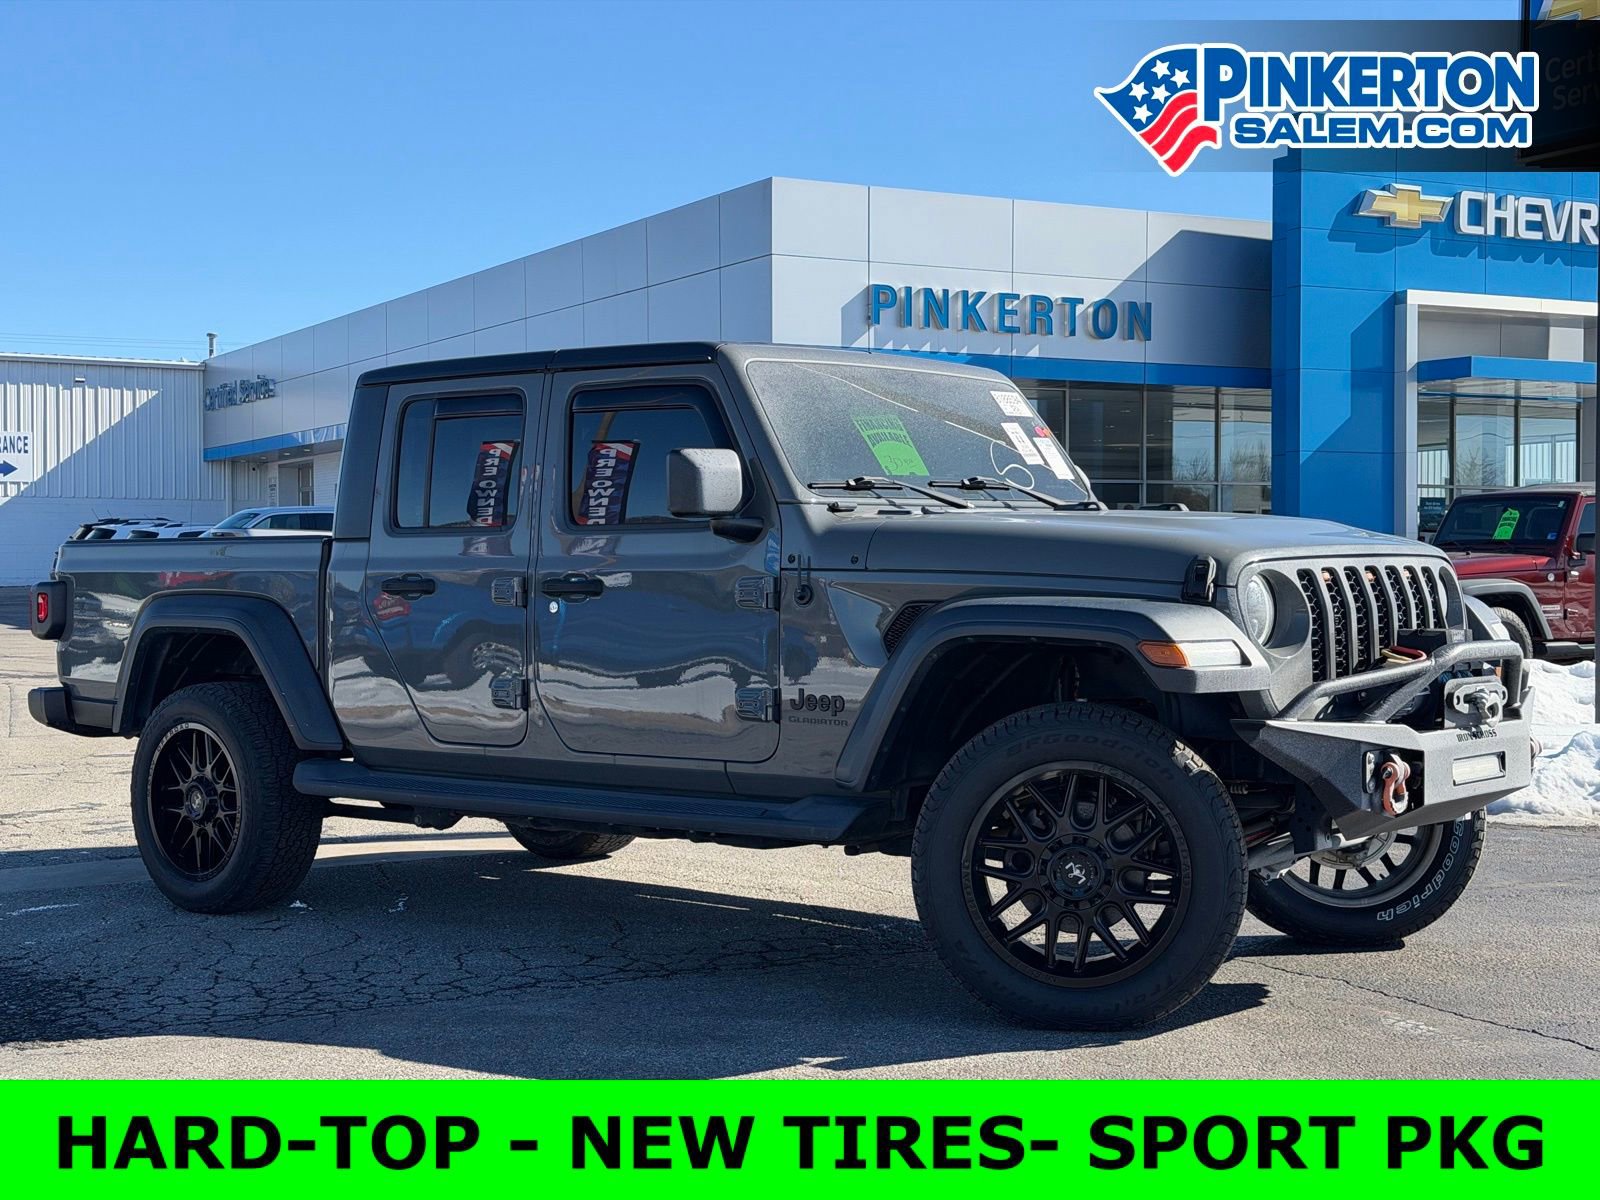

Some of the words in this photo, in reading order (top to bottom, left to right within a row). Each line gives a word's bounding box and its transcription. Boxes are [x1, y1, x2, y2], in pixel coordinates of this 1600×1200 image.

[1456, 190, 1599, 246] CHEVR
[867, 283, 1153, 342] PINKERTON
[0, 435, 29, 454] ANCE
[790, 688, 845, 716] Jeep
[788, 715, 849, 727] GLADIATOR
